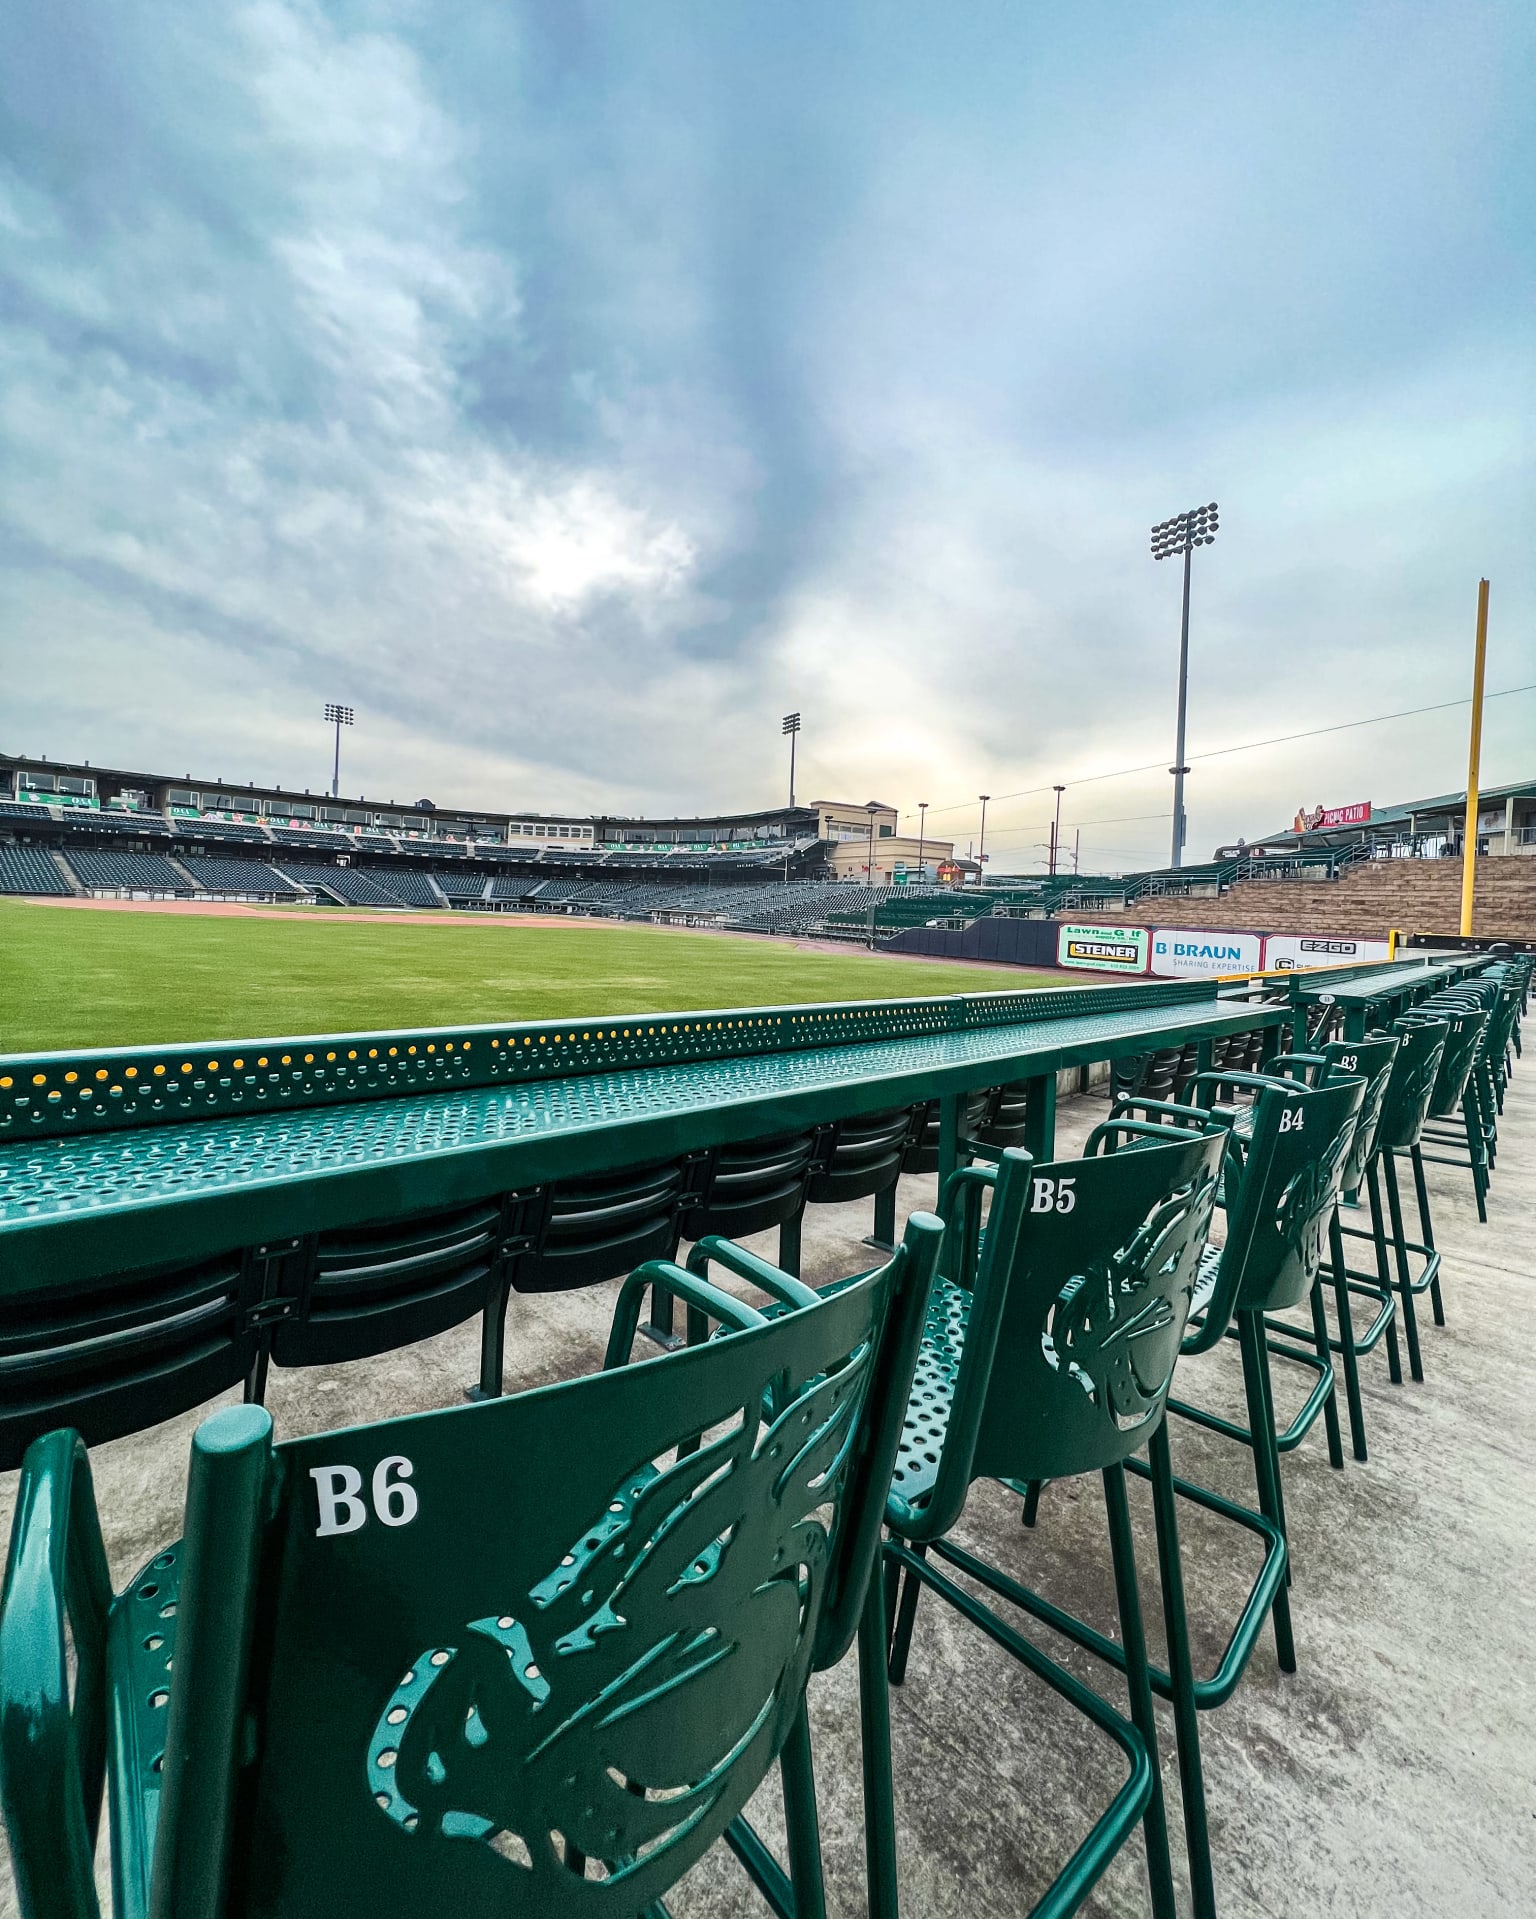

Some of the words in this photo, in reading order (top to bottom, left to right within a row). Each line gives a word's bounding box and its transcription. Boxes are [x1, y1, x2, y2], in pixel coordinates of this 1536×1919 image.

[1323, 810, 1344, 825] PICNIC
[1345, 806, 1364, 821] PATIO
[1067, 927, 1100, 935] Lawn
[1075, 943, 1136, 958] STEINER
[1155, 942, 1167, 954] B
[1174, 943, 1241, 960] BRAUN
[1173, 959, 1208, 969] SHARING
[1211, 962, 1255, 972] EXPERTISE
[1402, 1033, 1413, 1047] B
[1341, 1055, 1358, 1072] B3
[1278, 1107, 1304, 1133] B4
[1030, 1177, 1077, 1214] B5
[309, 1455, 418, 1537] B6
